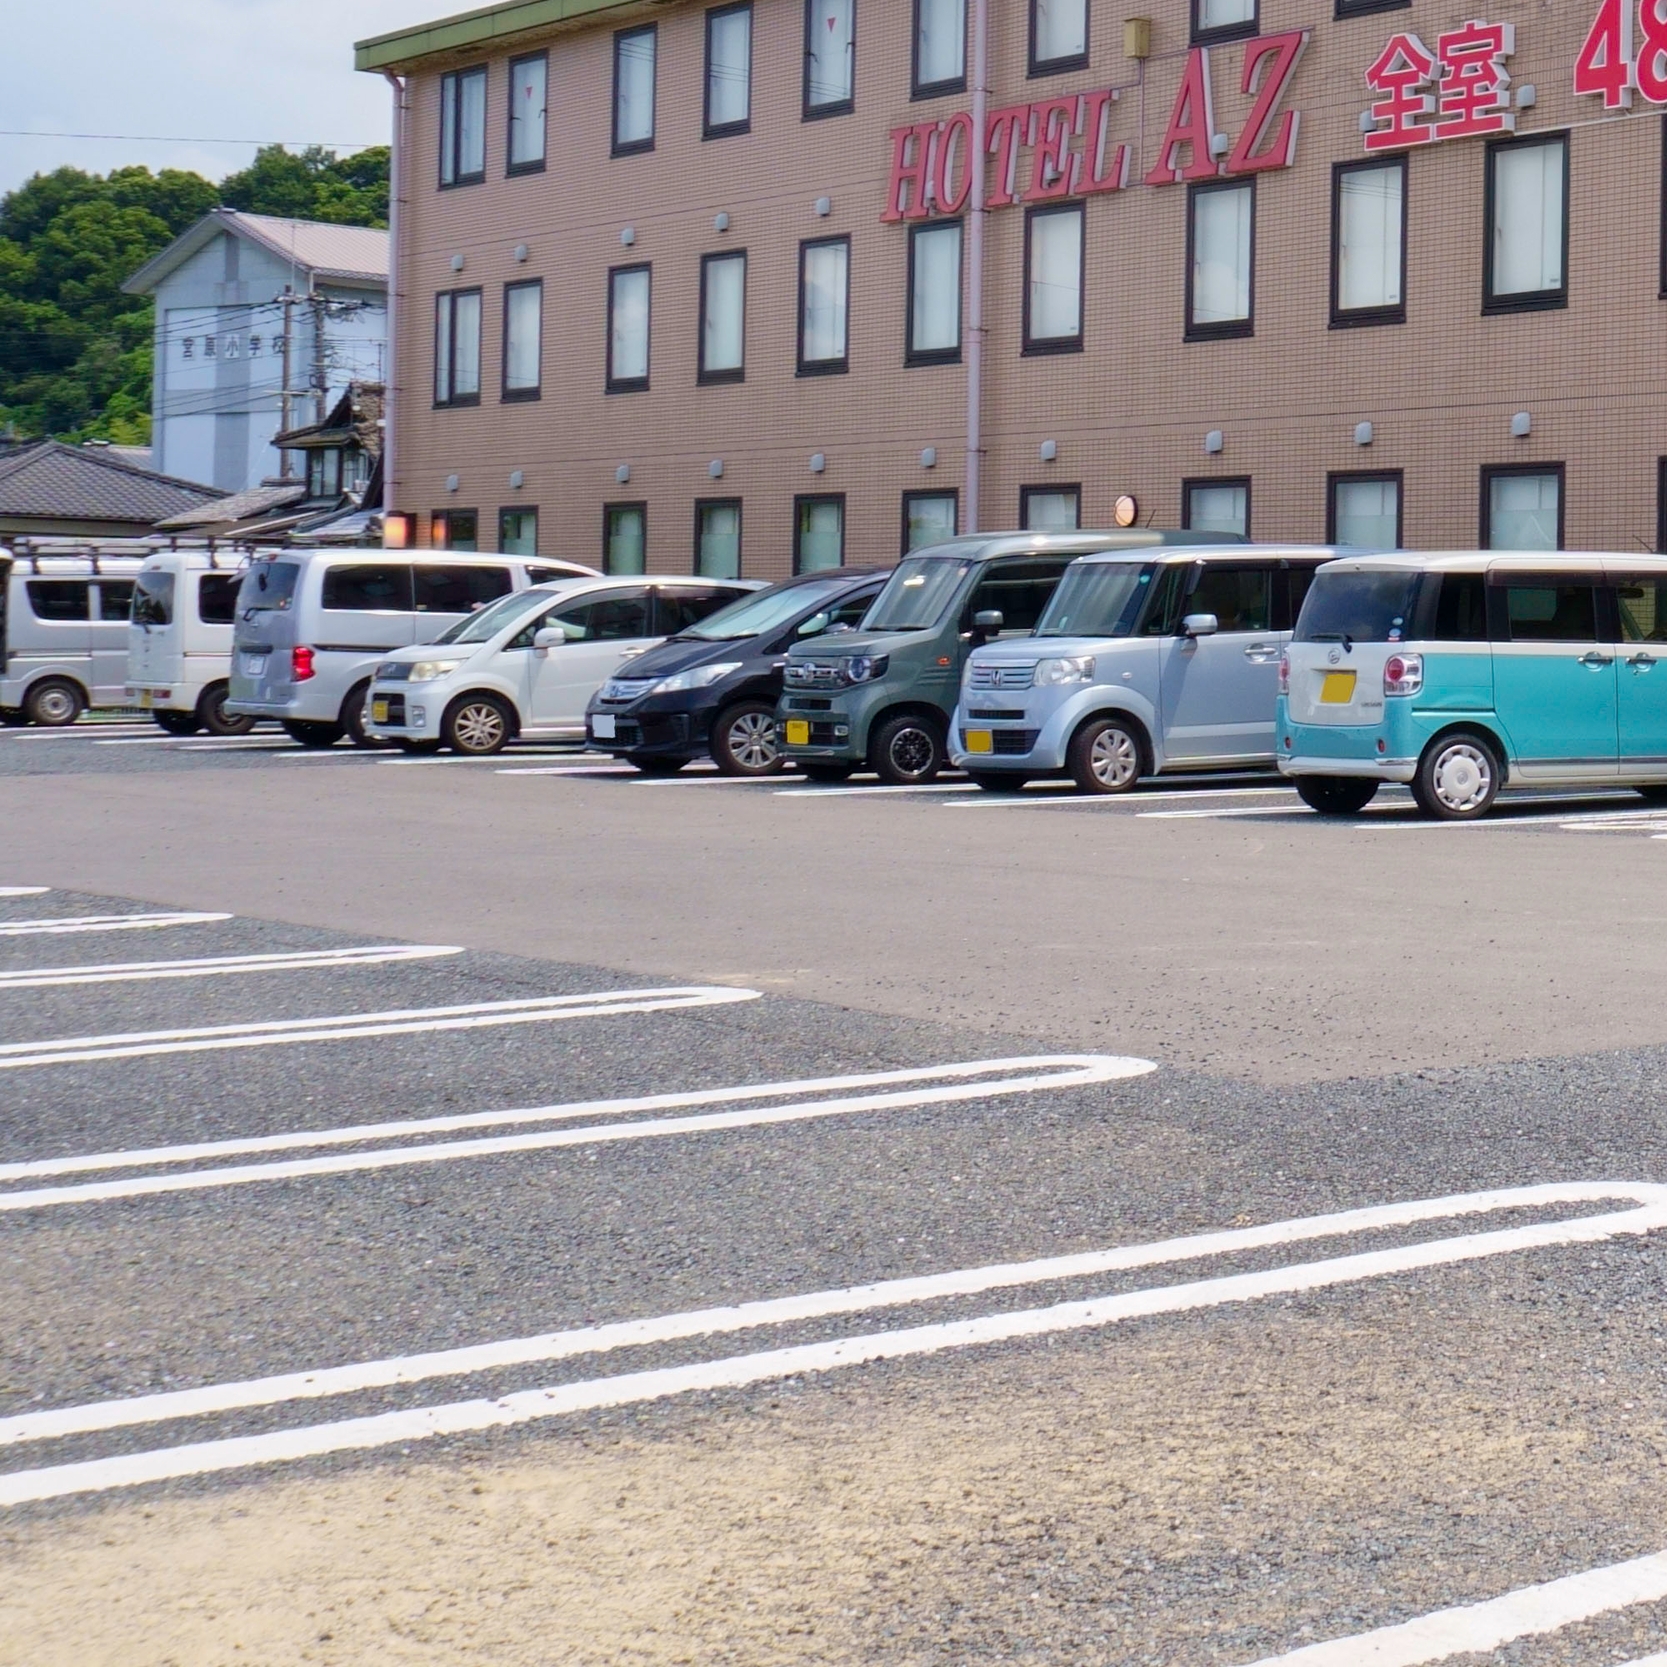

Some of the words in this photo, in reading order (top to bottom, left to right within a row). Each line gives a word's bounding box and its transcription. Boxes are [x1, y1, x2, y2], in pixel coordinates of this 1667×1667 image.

[880, 89, 1131, 223] HOTEL
[1145, 31, 1310, 186] AZ
[1364, 19, 1515, 152] 全室
